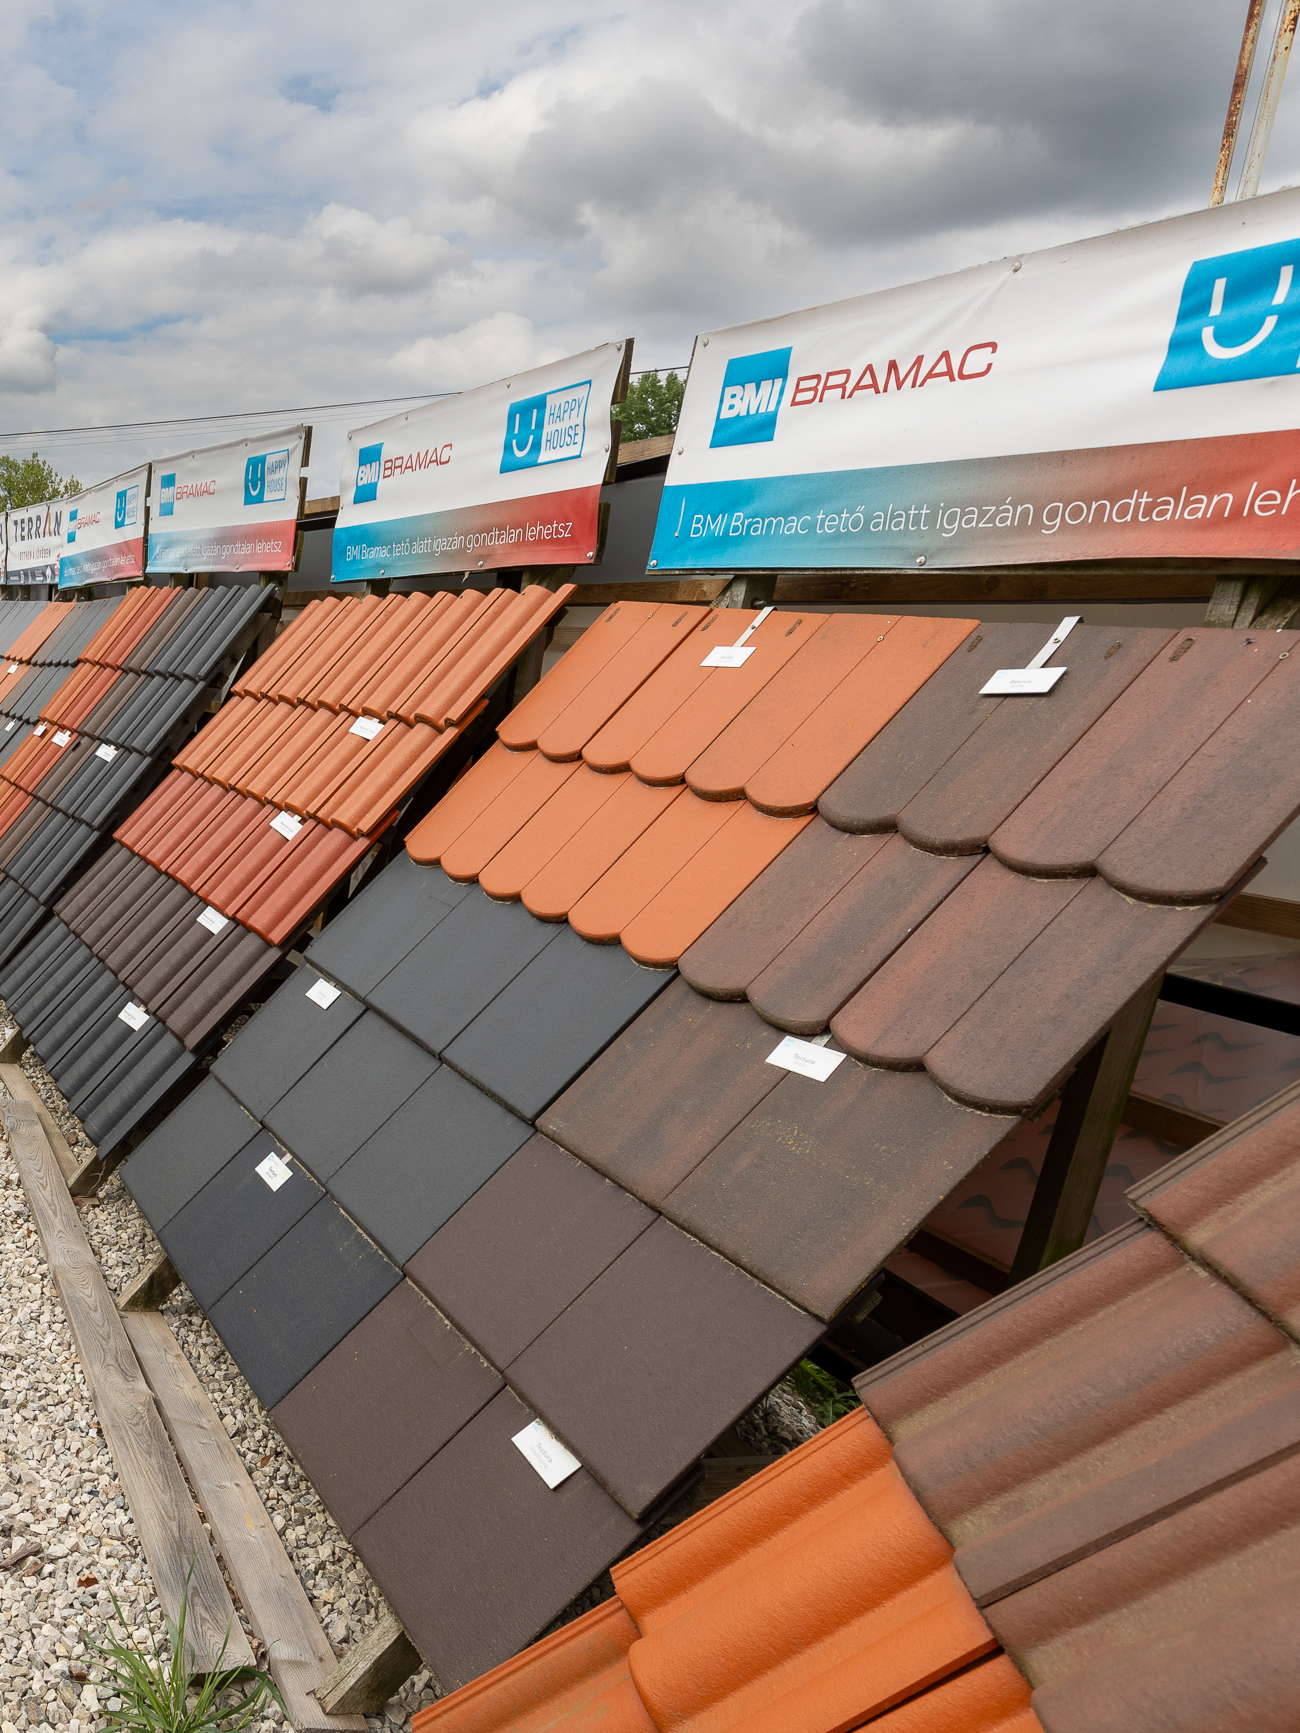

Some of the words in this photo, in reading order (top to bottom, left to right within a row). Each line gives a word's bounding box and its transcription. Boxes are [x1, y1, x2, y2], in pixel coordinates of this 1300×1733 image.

[719, 378, 783, 420] BMI
[790, 341, 998, 407] BRAMAC
[548, 396, 584, 426] HAPPY
[545, 423, 580, 451] HOUSE
[266, 459, 286, 475] HAPPY
[357, 461, 379, 487] BMI
[382, 443, 453, 480] BRAMAC
[161, 486, 175, 504] BMI
[176, 480, 216, 501] BRAMAC
[266, 477, 284, 493] HOUSE
[77, 511, 101, 530] BRAMAC
[690, 513, 728, 538] BMI
[728, 512, 811, 536] Bramac
[816, 505, 865, 533] tető
[870, 503, 938, 532] alatt
[936, 496, 1034, 537] igazán
[1041, 486, 1233, 534] gondtalan
[201, 541, 222, 560] igazán
[222, 540, 255, 559] gondtalan
[256, 538, 282, 553] lehetsz
[346, 545, 361, 562] BMI
[361, 542, 391, 560] Bramac
[392, 538, 411, 556] tető
[411, 536, 432, 555] alatt
[432, 532, 465, 555] igazán
[466, 525, 523, 553] gondtalan
[525, 520, 573, 542] lehetsz
[793, 1053, 815, 1065] Tectura
[536, 1441, 553, 1463] Tectura
